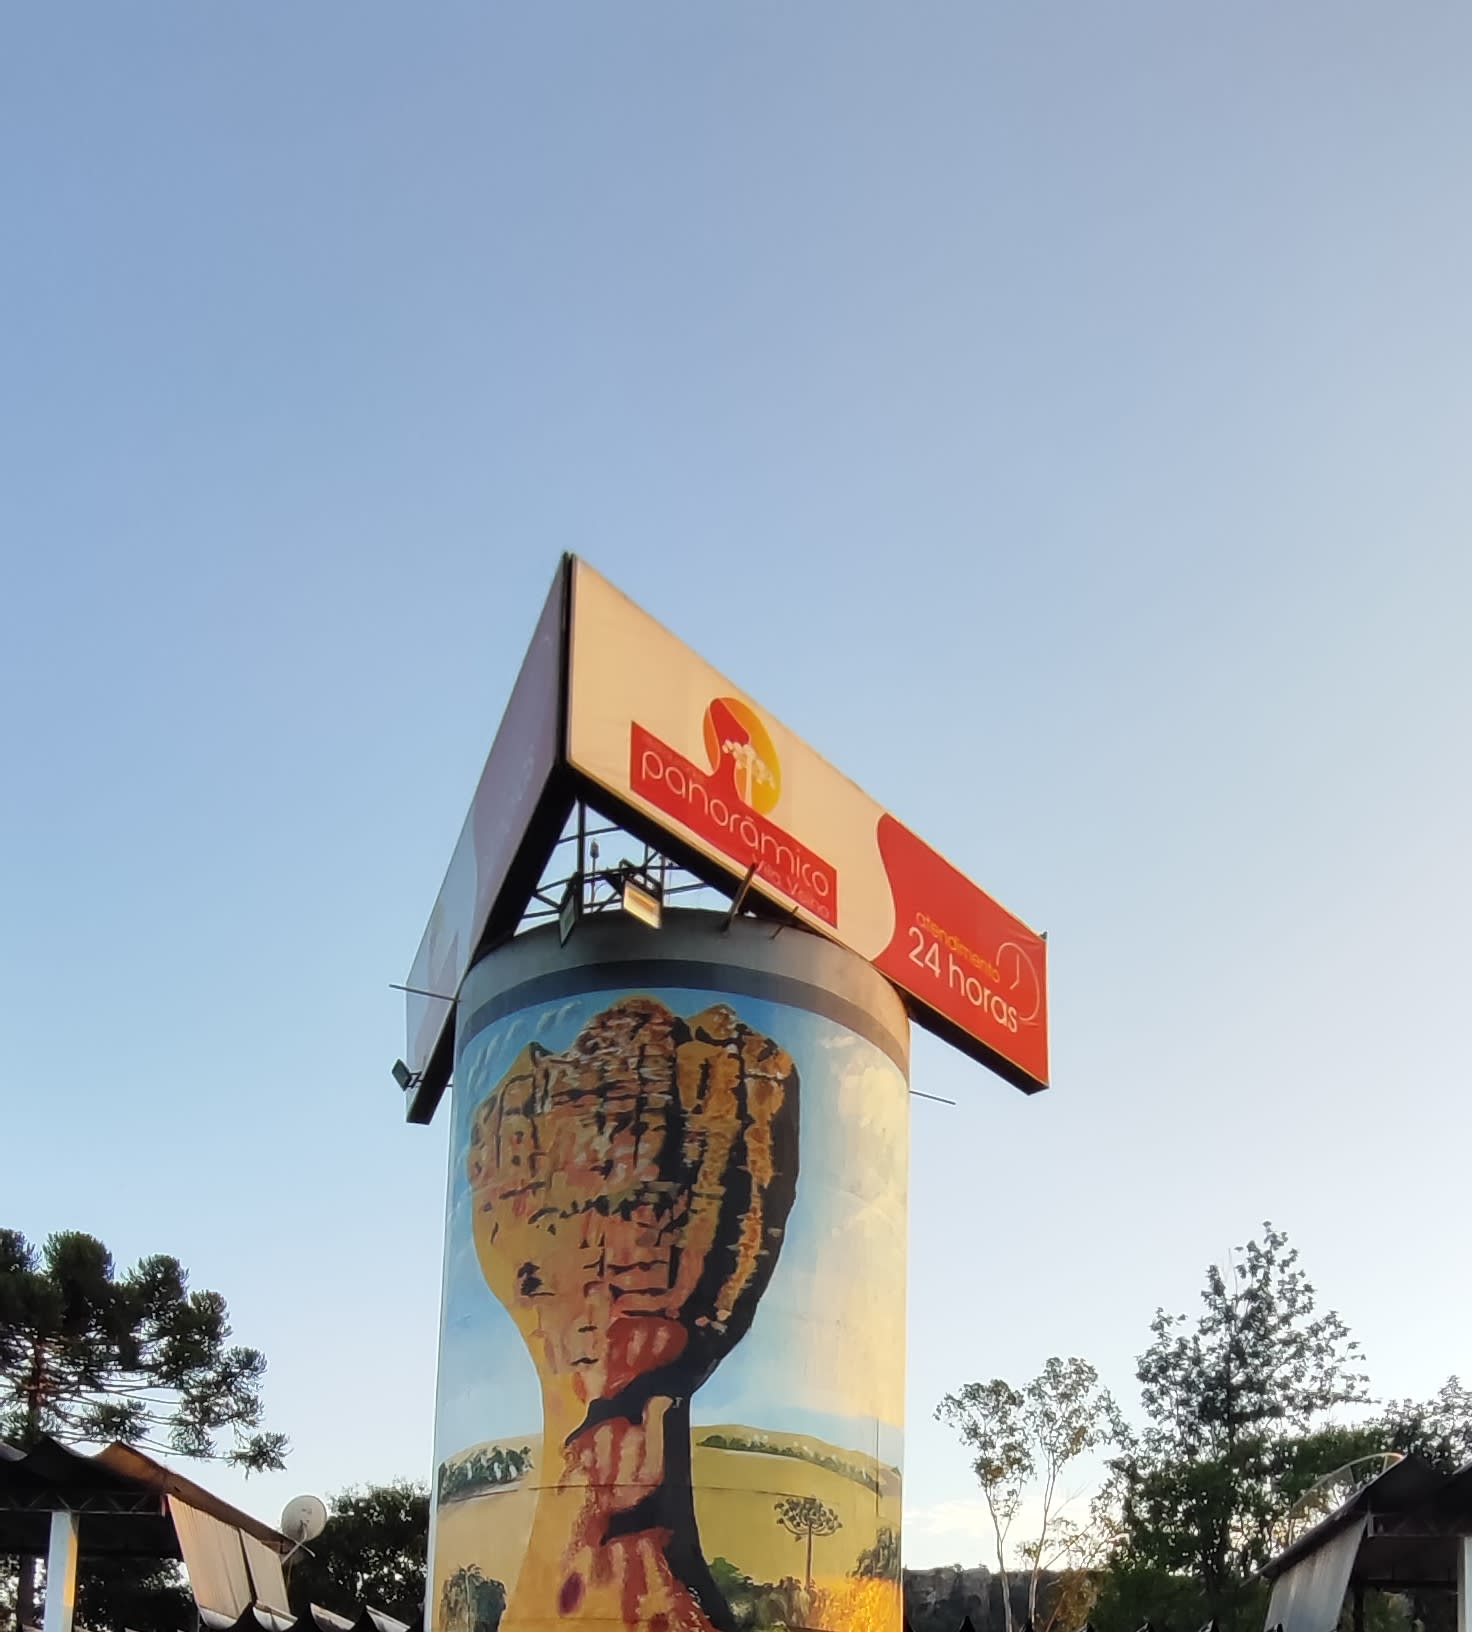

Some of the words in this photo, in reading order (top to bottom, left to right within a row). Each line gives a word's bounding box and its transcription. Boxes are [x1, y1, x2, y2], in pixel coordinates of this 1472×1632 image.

[642, 751, 829, 896] panorâmico
[908, 926, 941, 978] 24
[949, 953, 1017, 1033] horas
[916, 912, 1000, 983] atendimento
